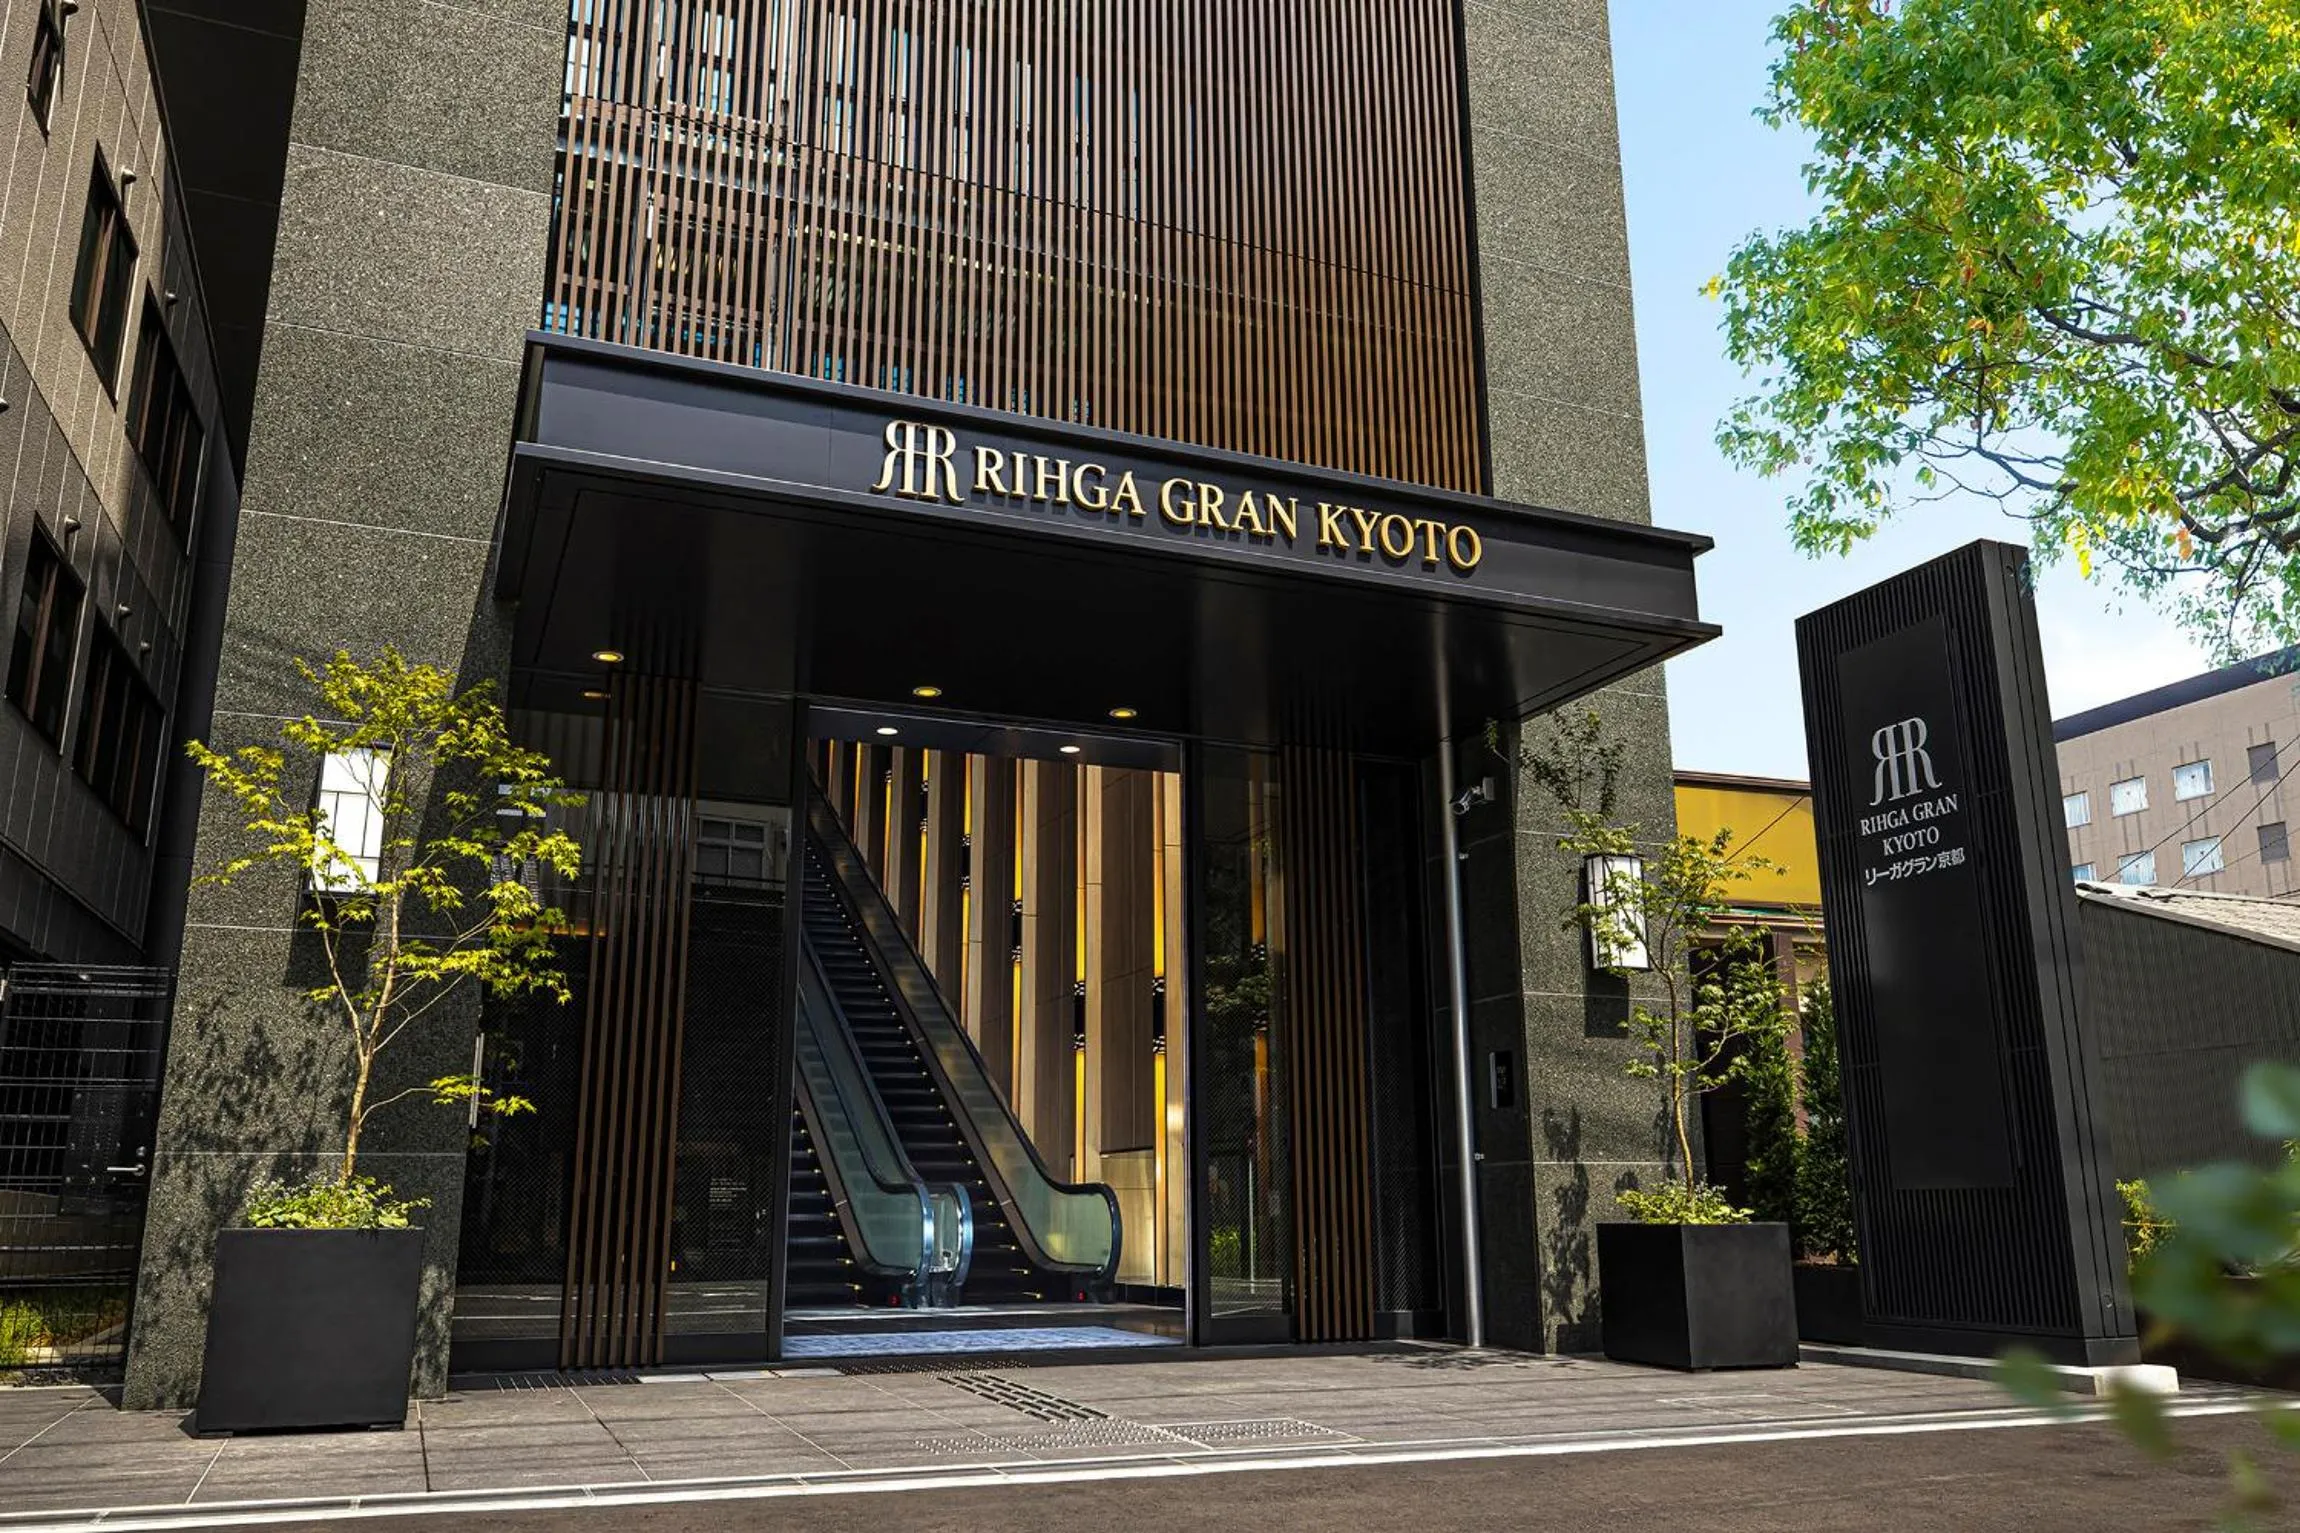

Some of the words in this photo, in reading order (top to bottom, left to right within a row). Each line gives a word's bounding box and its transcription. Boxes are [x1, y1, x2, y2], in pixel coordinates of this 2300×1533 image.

[973, 445, 1147, 517] RIHGA
[1161, 477, 1299, 539] GRAN
[1318, 502, 1483, 571] KYOTO
[1860, 807, 1909, 836] RIHGA
[1912, 793, 1959, 822] GRAN
[1883, 826, 1940, 856] KYOTO
[1864, 847, 1966, 886] リーガグラン京都
